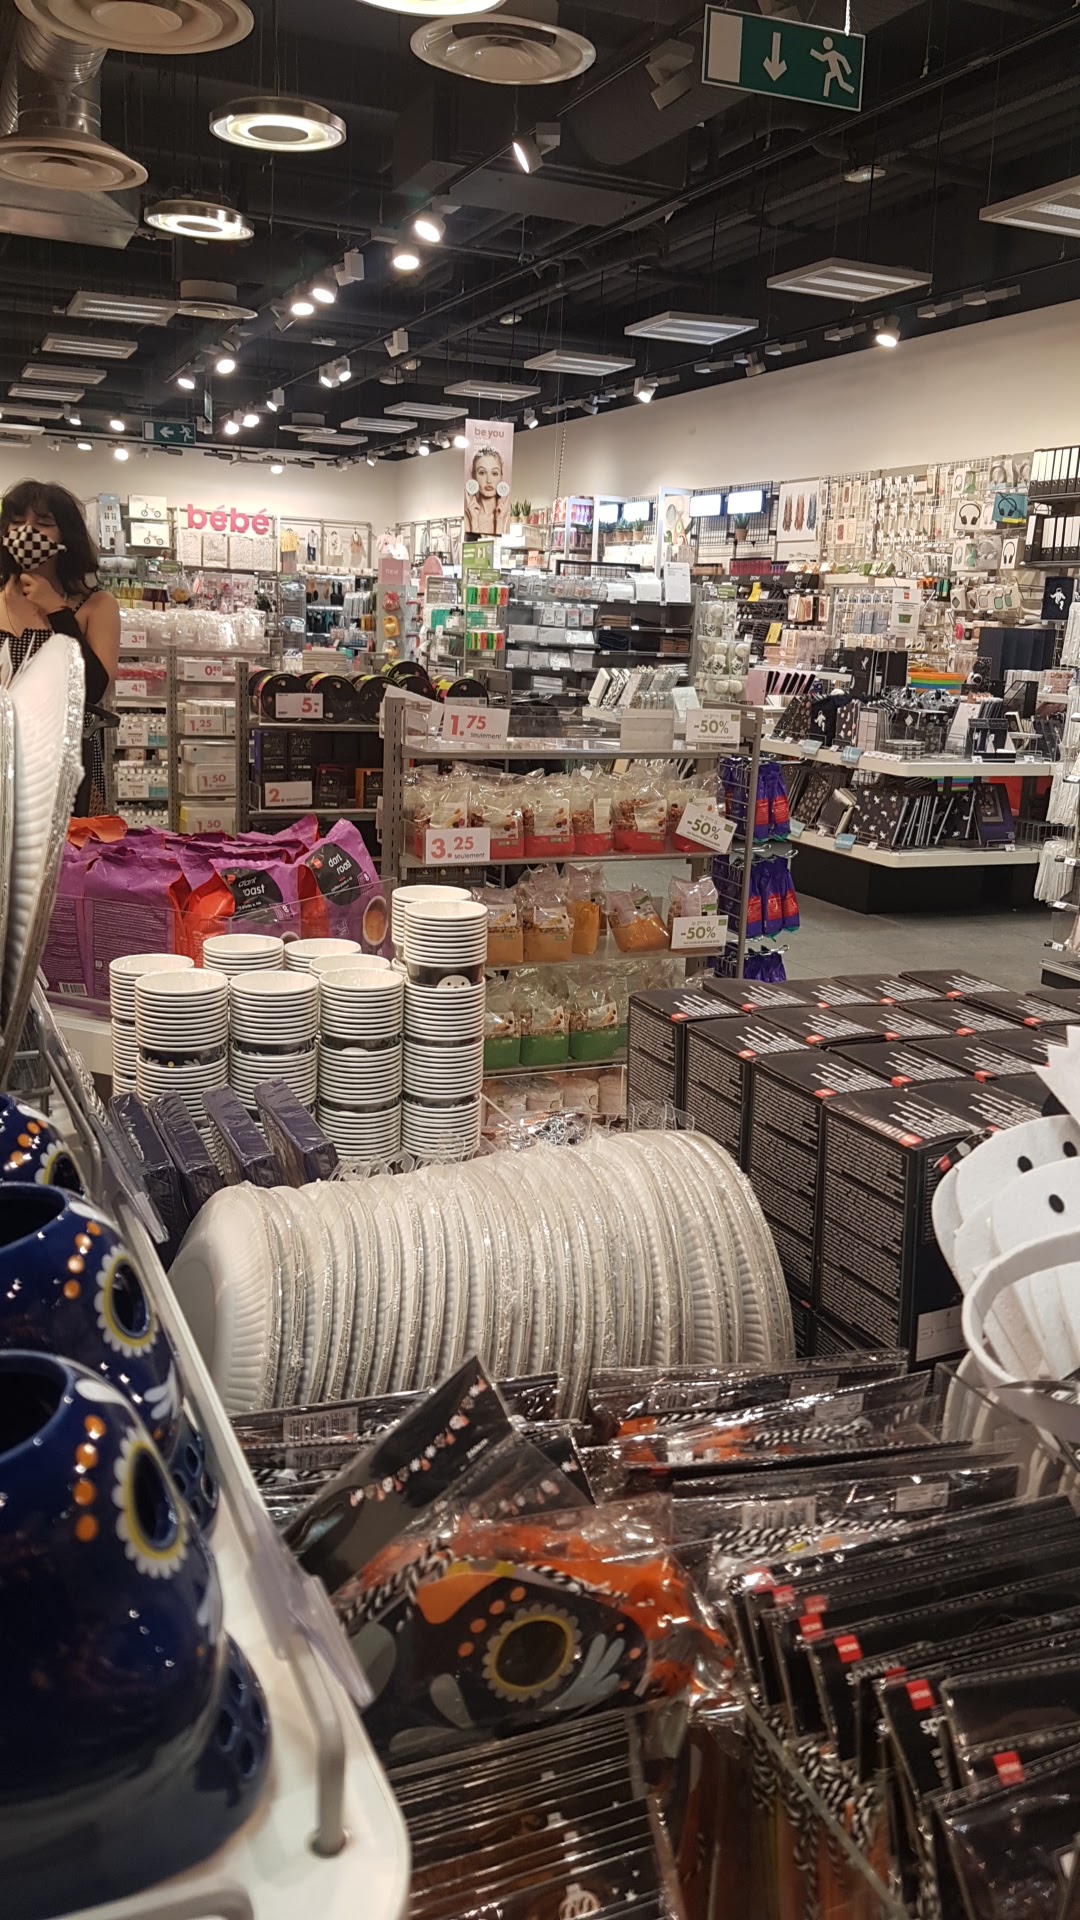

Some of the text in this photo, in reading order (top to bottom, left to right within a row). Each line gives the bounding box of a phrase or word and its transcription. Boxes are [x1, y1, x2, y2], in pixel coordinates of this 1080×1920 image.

[474, 426, 505, 439] be you
[187, 504, 270, 536] bébé
[693, 719, 729, 734] -50%
[470, 731, 502, 740] seulement
[687, 818, 721, 840] -50%
[454, 852, 486, 860] seulement
[336, 859, 353, 876] roast
[680, 926, 716, 940] -50%
